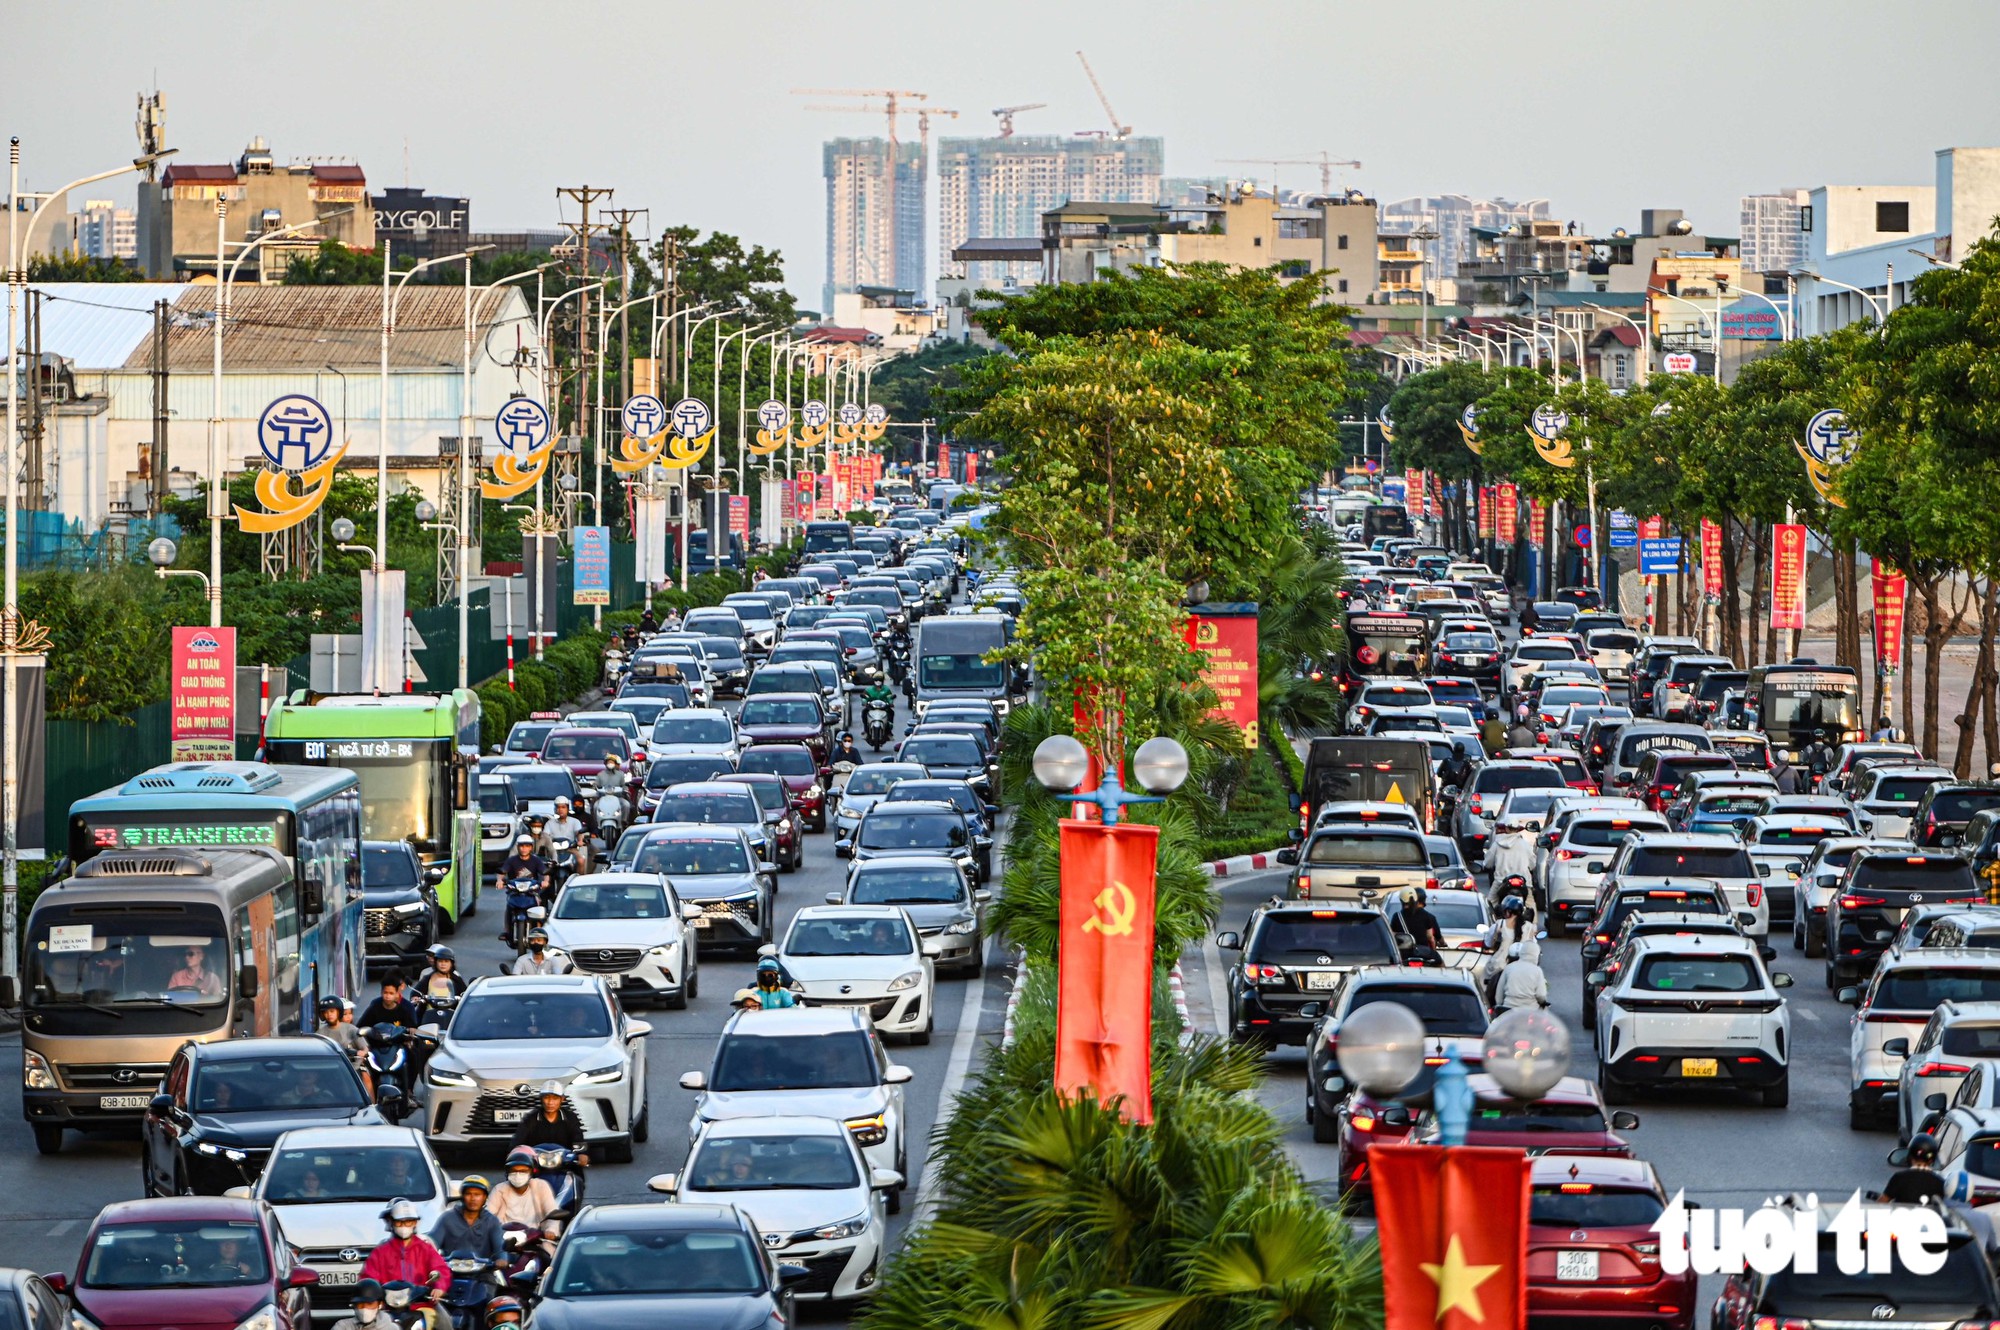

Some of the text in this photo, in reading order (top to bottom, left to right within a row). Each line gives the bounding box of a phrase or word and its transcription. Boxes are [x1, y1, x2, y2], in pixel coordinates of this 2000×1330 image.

[187, 656, 220, 670] AN TOÀN
[181, 674, 226, 688] GIAO THÔNG
[175, 694, 231, 710] LÀ HẠNH PHÚC
[176, 713, 193, 728] CỦA
[194, 717, 209, 730] MỌI
[305, 741, 325, 759] E01
[1651, 735, 1670, 748] THẤT
[1671, 737, 1698, 751] AZUMY
[101, 1097, 149, 1108] 29B-210.70
[1567, 1253, 1588, 1264] 30G
[319, 1273, 359, 1285] 30A-50
